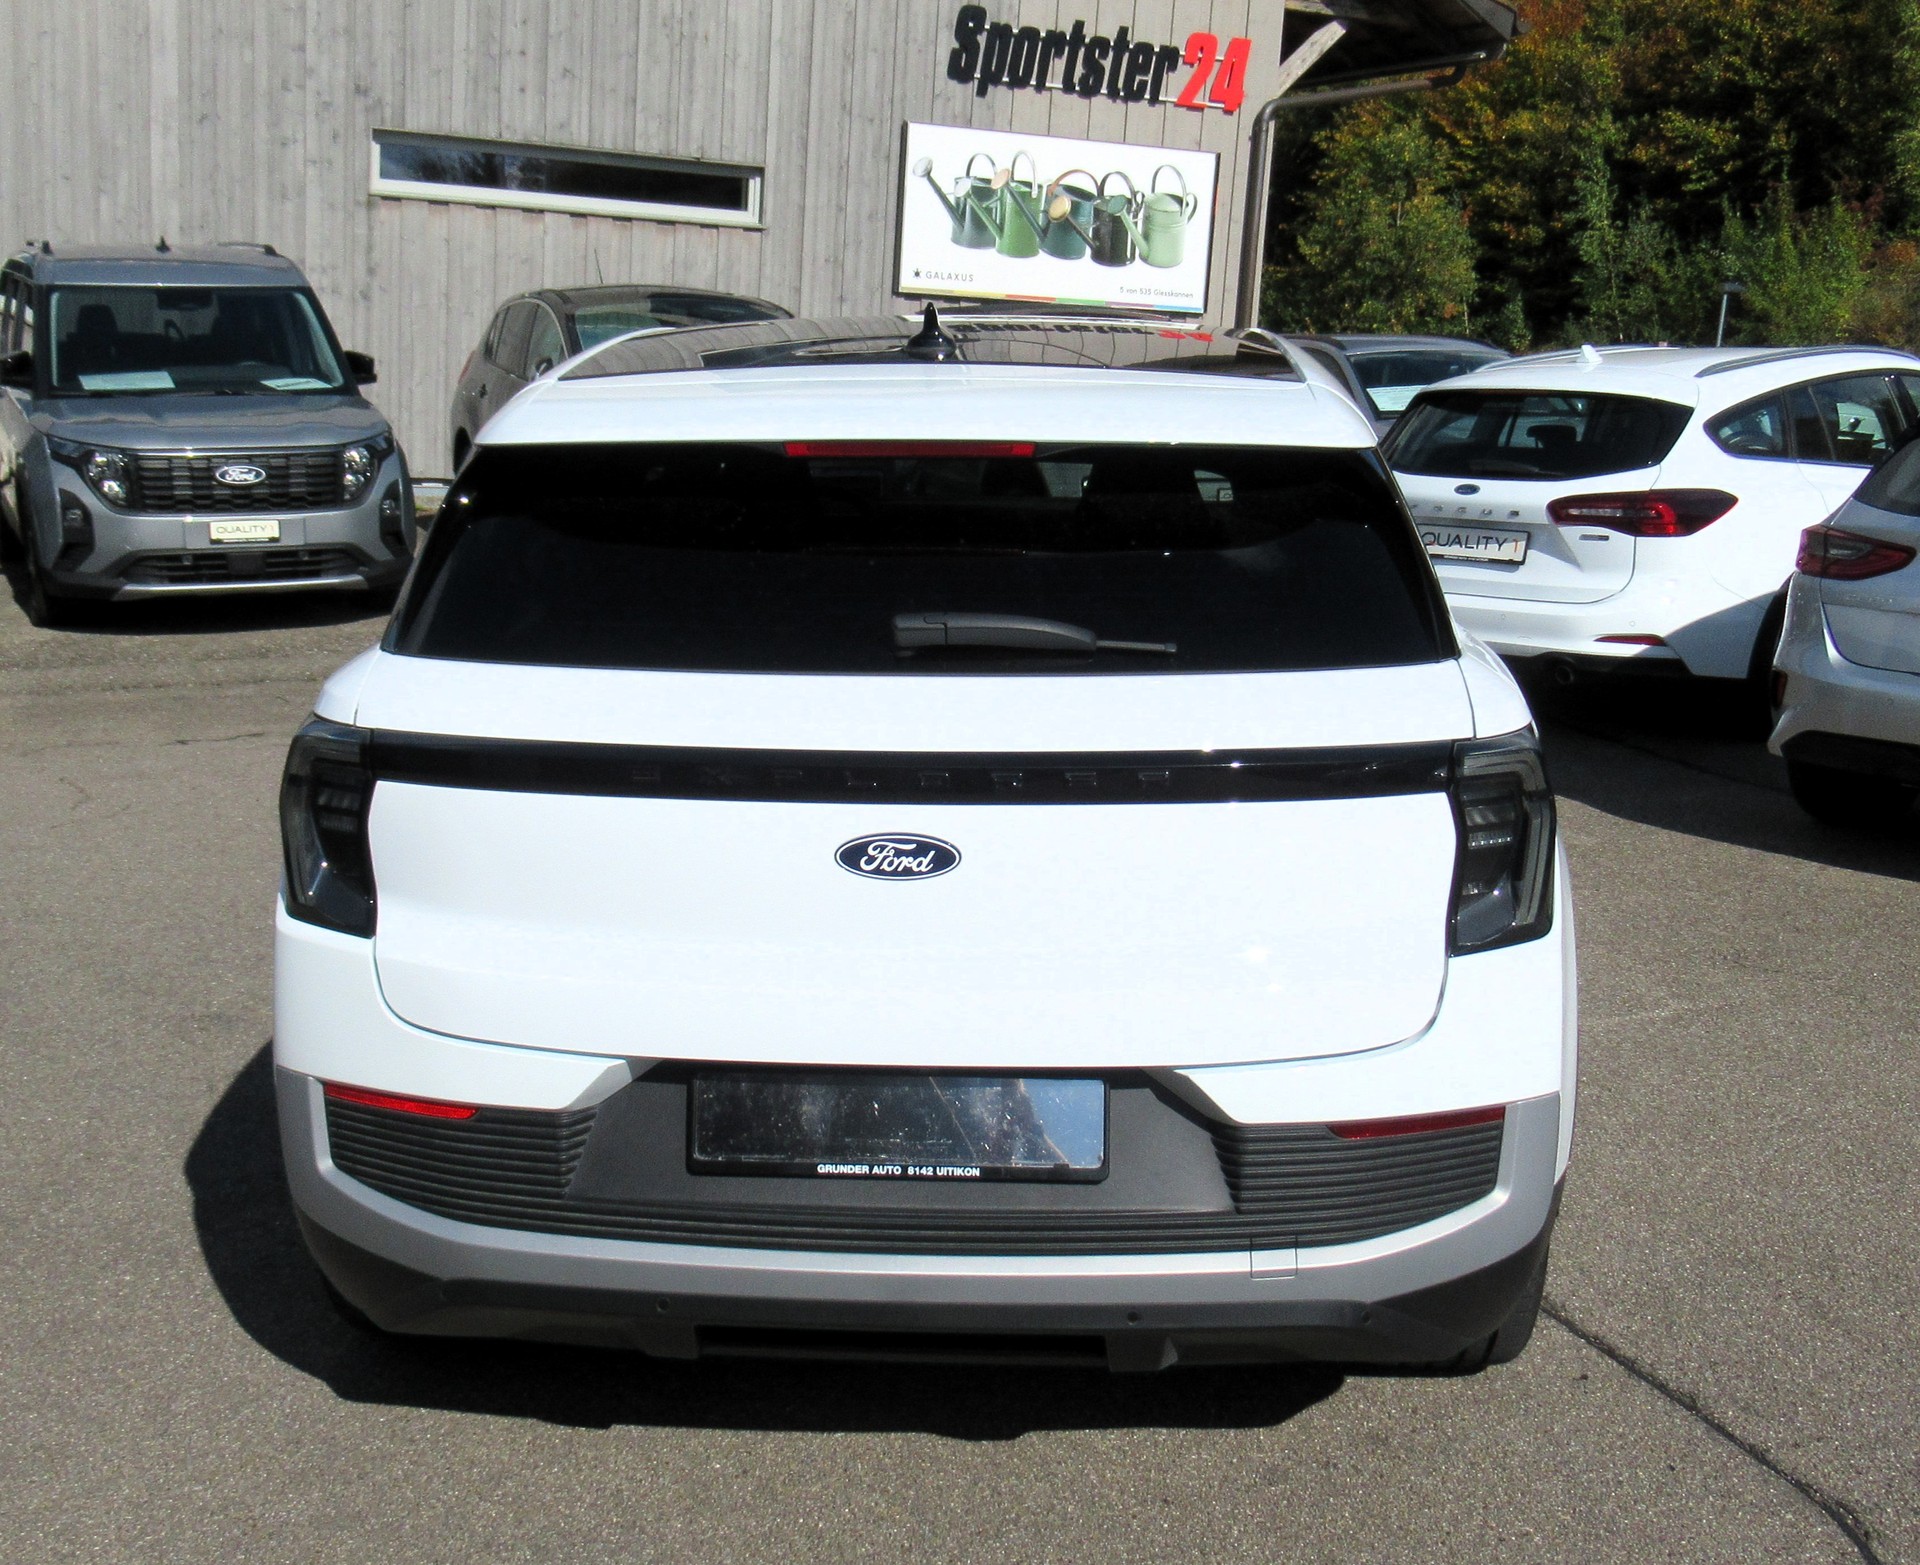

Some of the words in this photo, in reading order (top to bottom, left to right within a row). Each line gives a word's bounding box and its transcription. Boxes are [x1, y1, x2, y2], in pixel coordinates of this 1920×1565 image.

[947, 4, 1251, 112] Sportster24
[925, 270, 974, 282] GALAXUS
[216, 525, 266, 534] QUALITY
[1421, 531, 1508, 552] QUALITY
[859, 841, 934, 872] Ford
[816, 1163, 870, 1175] GRUNDER
[872, 1165, 902, 1175] AUTO
[907, 1166, 934, 1176] 8142
[936, 1167, 981, 1177] UITIKON
